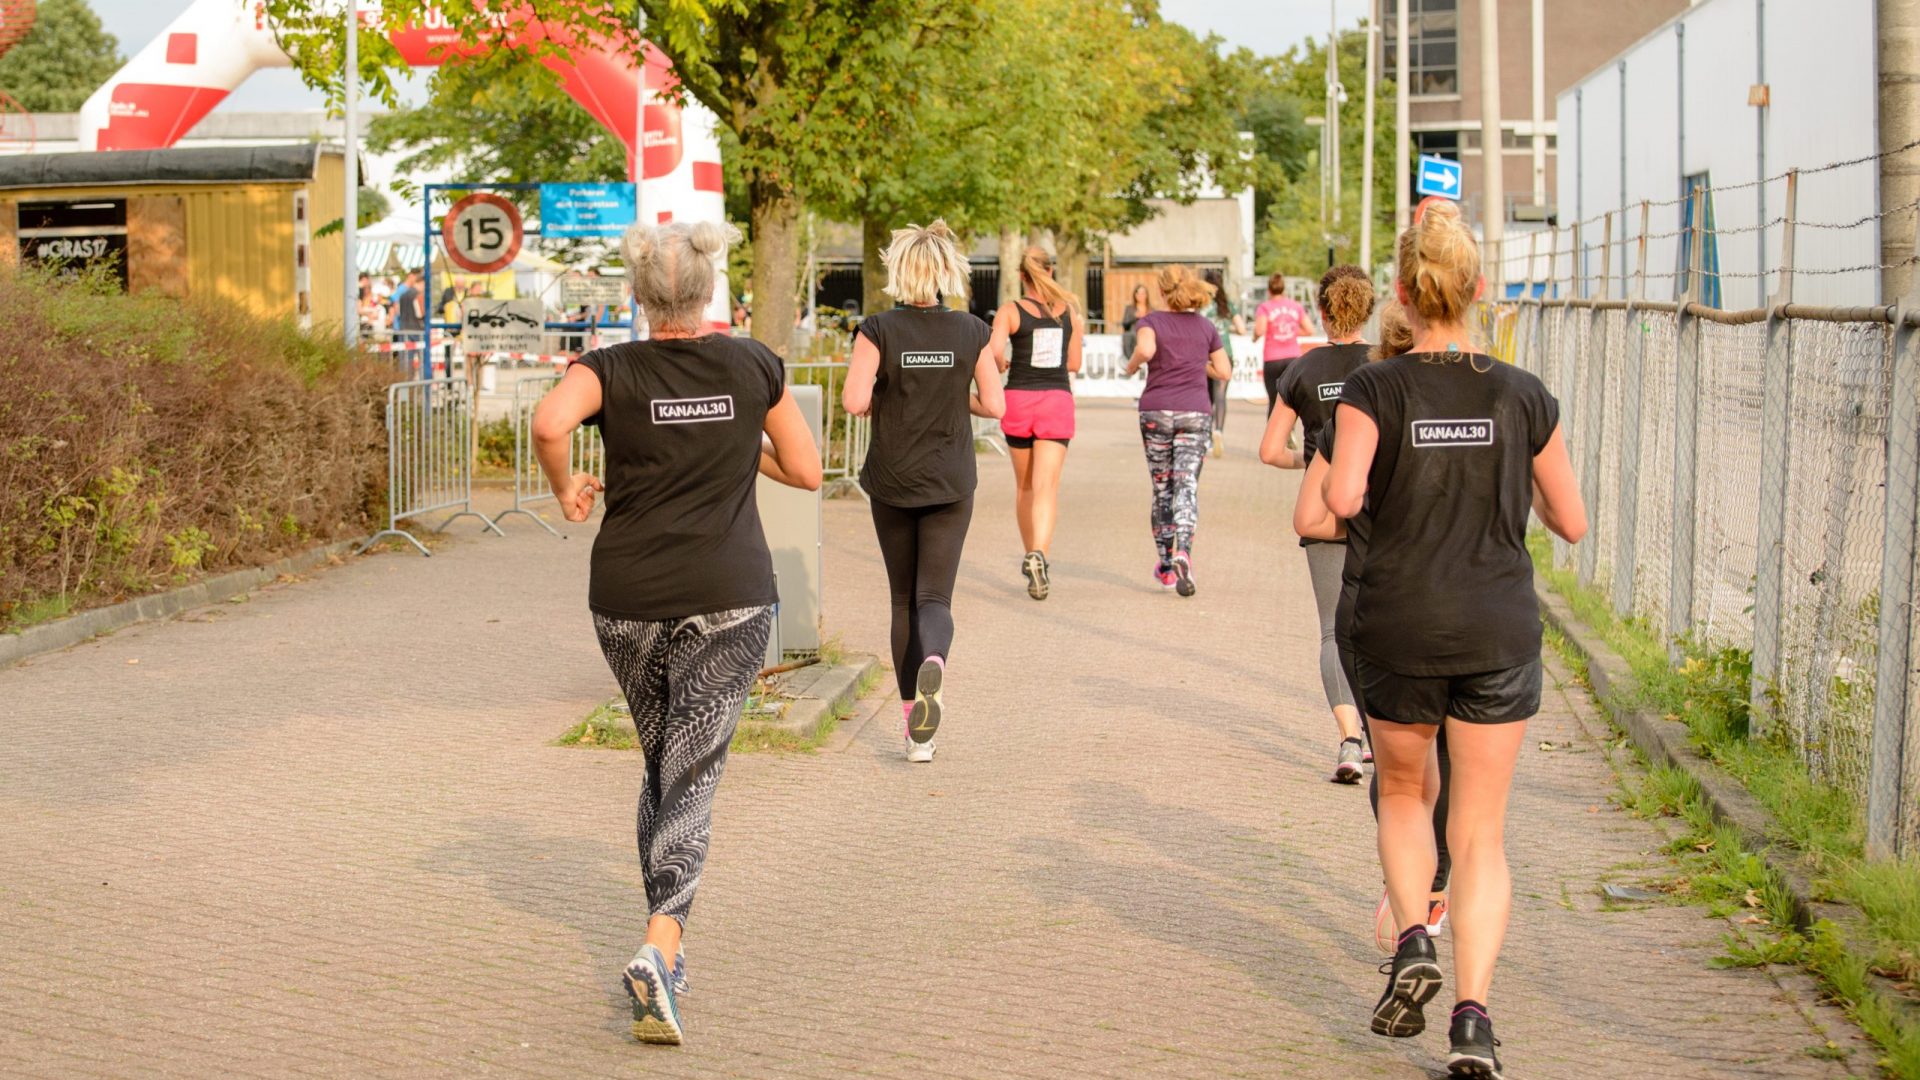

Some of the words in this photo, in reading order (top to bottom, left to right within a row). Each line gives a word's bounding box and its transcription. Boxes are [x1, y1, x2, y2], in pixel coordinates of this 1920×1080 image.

[568, 188, 607, 196] Parkeren
[462, 217, 504, 251] 15
[499, 342, 528, 351] kracht
[906, 355, 950, 364] KANAAL30
[658, 402, 727, 417] KANAAL30
[1419, 426, 1487, 440] KANAAL30
